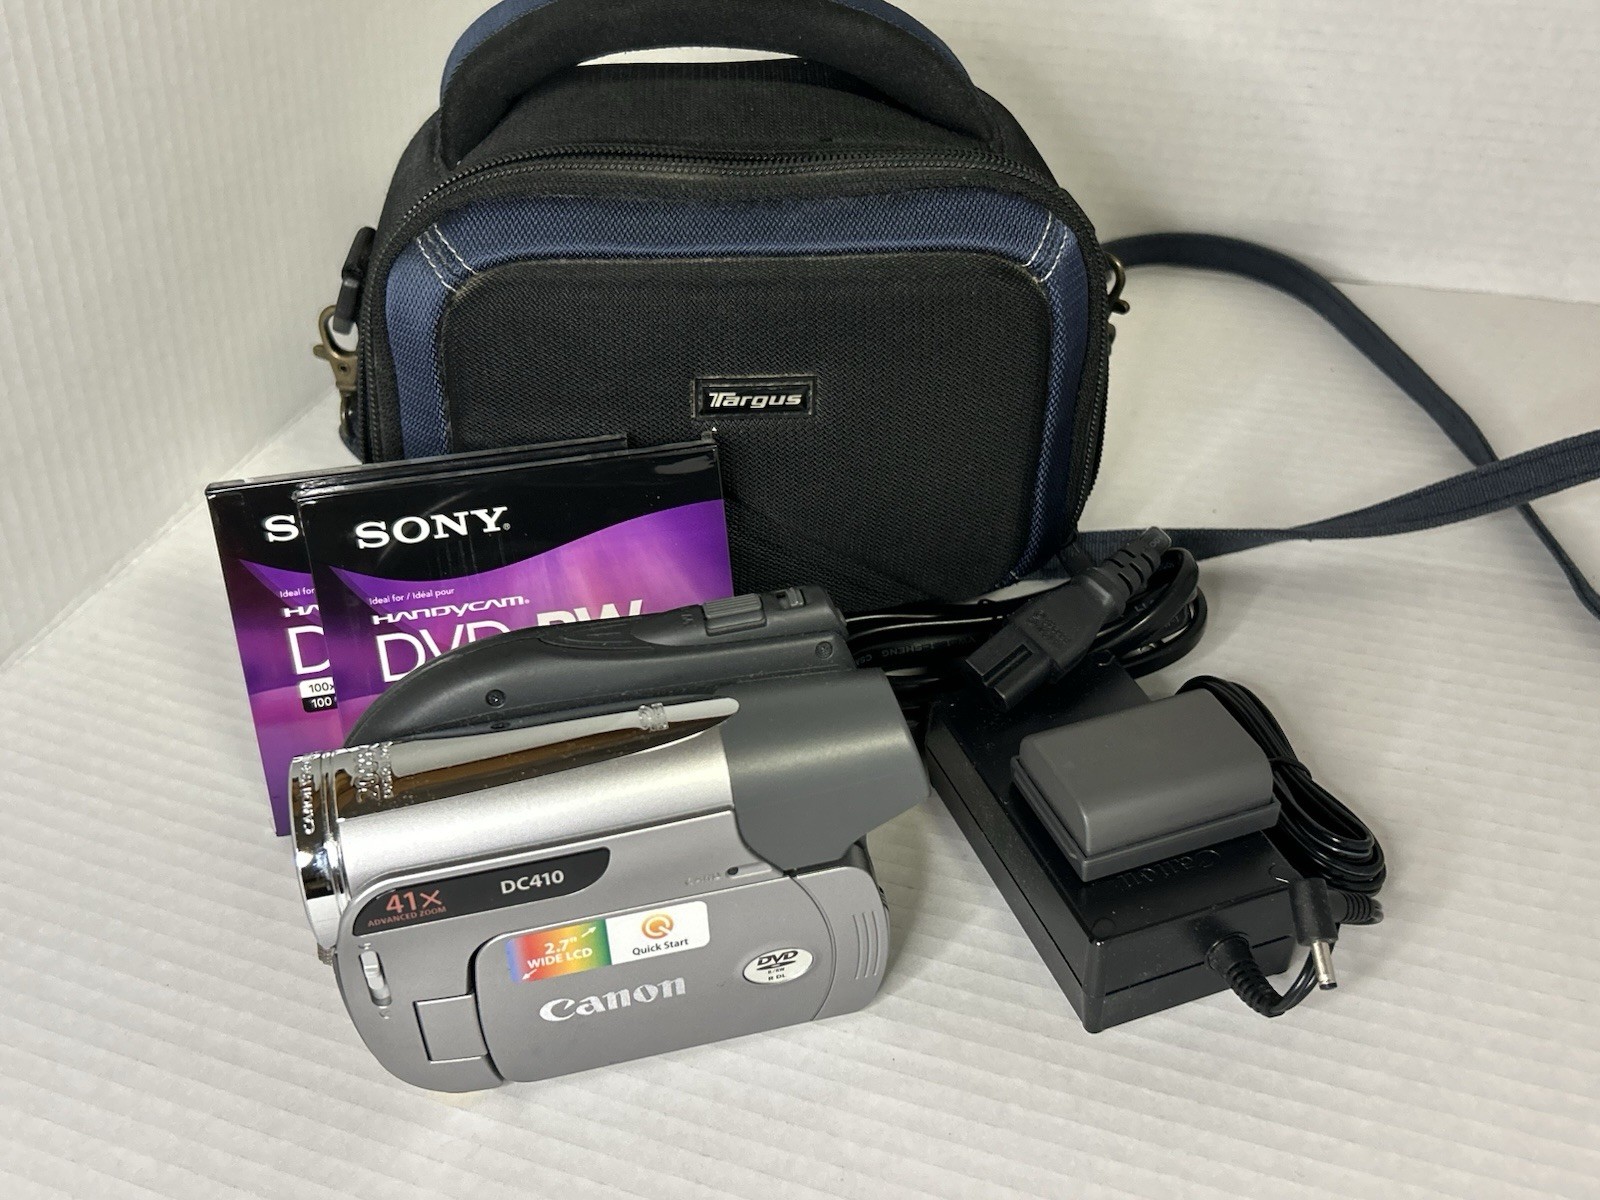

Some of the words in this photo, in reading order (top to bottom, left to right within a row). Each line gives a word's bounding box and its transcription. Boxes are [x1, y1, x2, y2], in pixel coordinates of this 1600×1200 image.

[708, 391, 802, 409] Targus
[354, 506, 508, 549] SONY
[280, 588, 300, 598] Ideal
[302, 587, 315, 595] for
[369, 597, 390, 605] Ideal
[392, 594, 404, 602] for
[412, 589, 433, 599] Idéal
[435, 588, 455, 598] pour
[311, 696, 333, 709] 100
[500, 870, 565, 894] DC410
[367, 911, 418, 928] ADVANCED
[419, 906, 447, 919] ZOOM
[544, 936, 578, 955] 2.7"
[632, 941, 662, 956] Quick
[664, 938, 689, 949] Start
[527, 952, 564, 969] WIDE
[566, 947, 593, 962] LCD
[757, 950, 798, 966] DVD
[539, 977, 687, 1022] Canon
